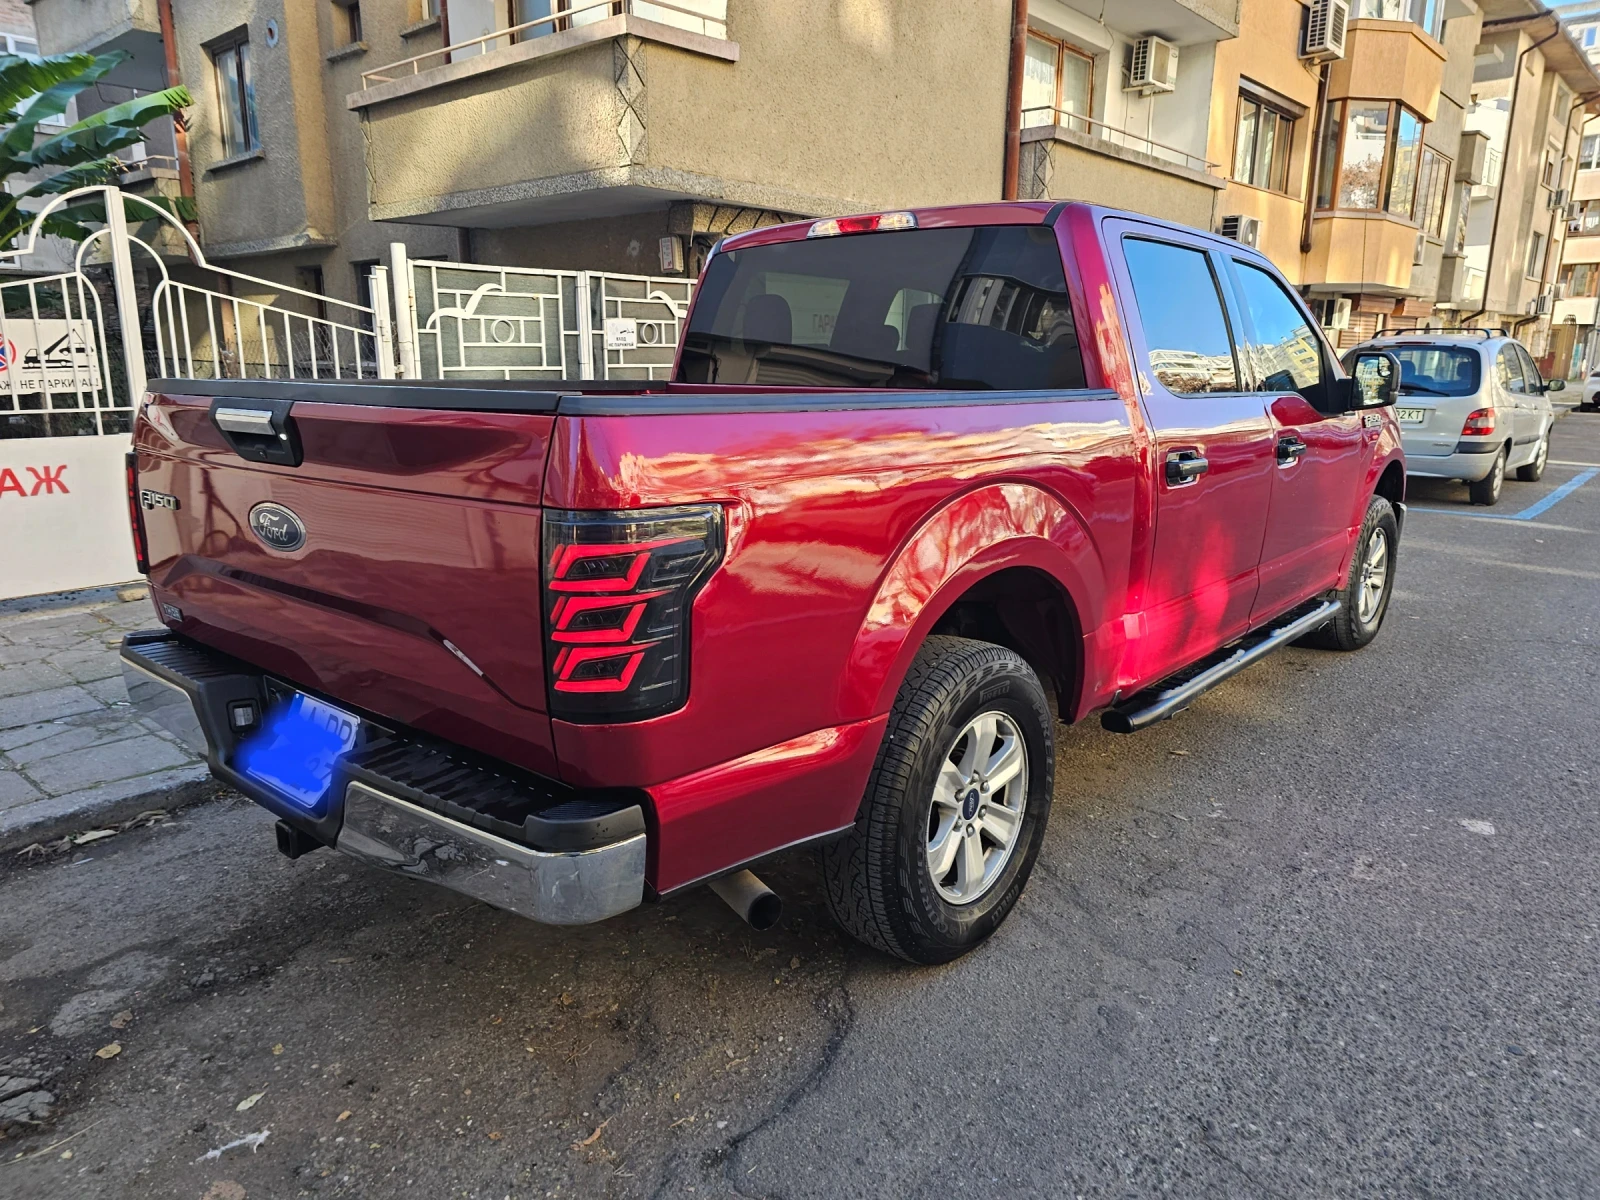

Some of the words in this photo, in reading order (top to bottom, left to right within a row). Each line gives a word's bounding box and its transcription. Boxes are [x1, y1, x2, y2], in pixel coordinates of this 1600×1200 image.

[20, 379, 36, 389] НЕ
[0, 464, 70, 498] АЖ
[258, 512, 288, 542] Ford
[978, 680, 1010, 705] PIRELLI
[1031, 701, 1053, 802] PIRELLI
